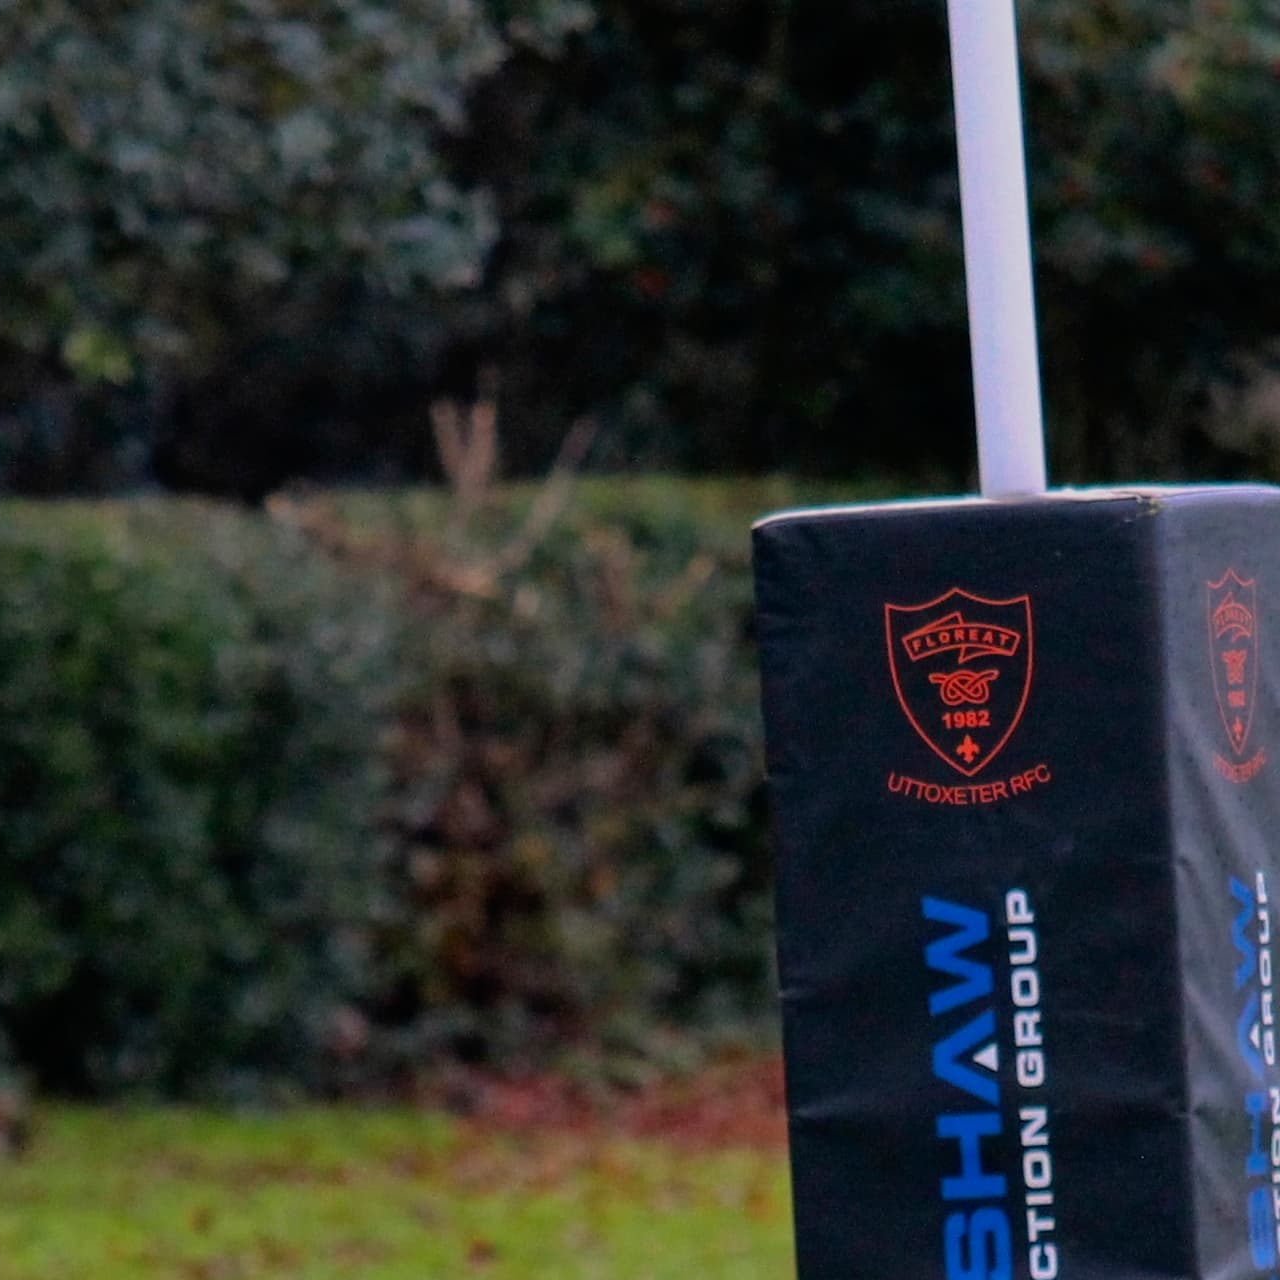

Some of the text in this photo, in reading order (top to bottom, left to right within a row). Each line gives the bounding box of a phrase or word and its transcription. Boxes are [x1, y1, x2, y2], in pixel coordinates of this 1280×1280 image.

[913, 629, 1010, 650] FLOREAT
[942, 710, 990, 729] 1982
[888, 764, 1051, 805] UTTOXETER RFC
[1005, 888, 1046, 1088] GROUP
